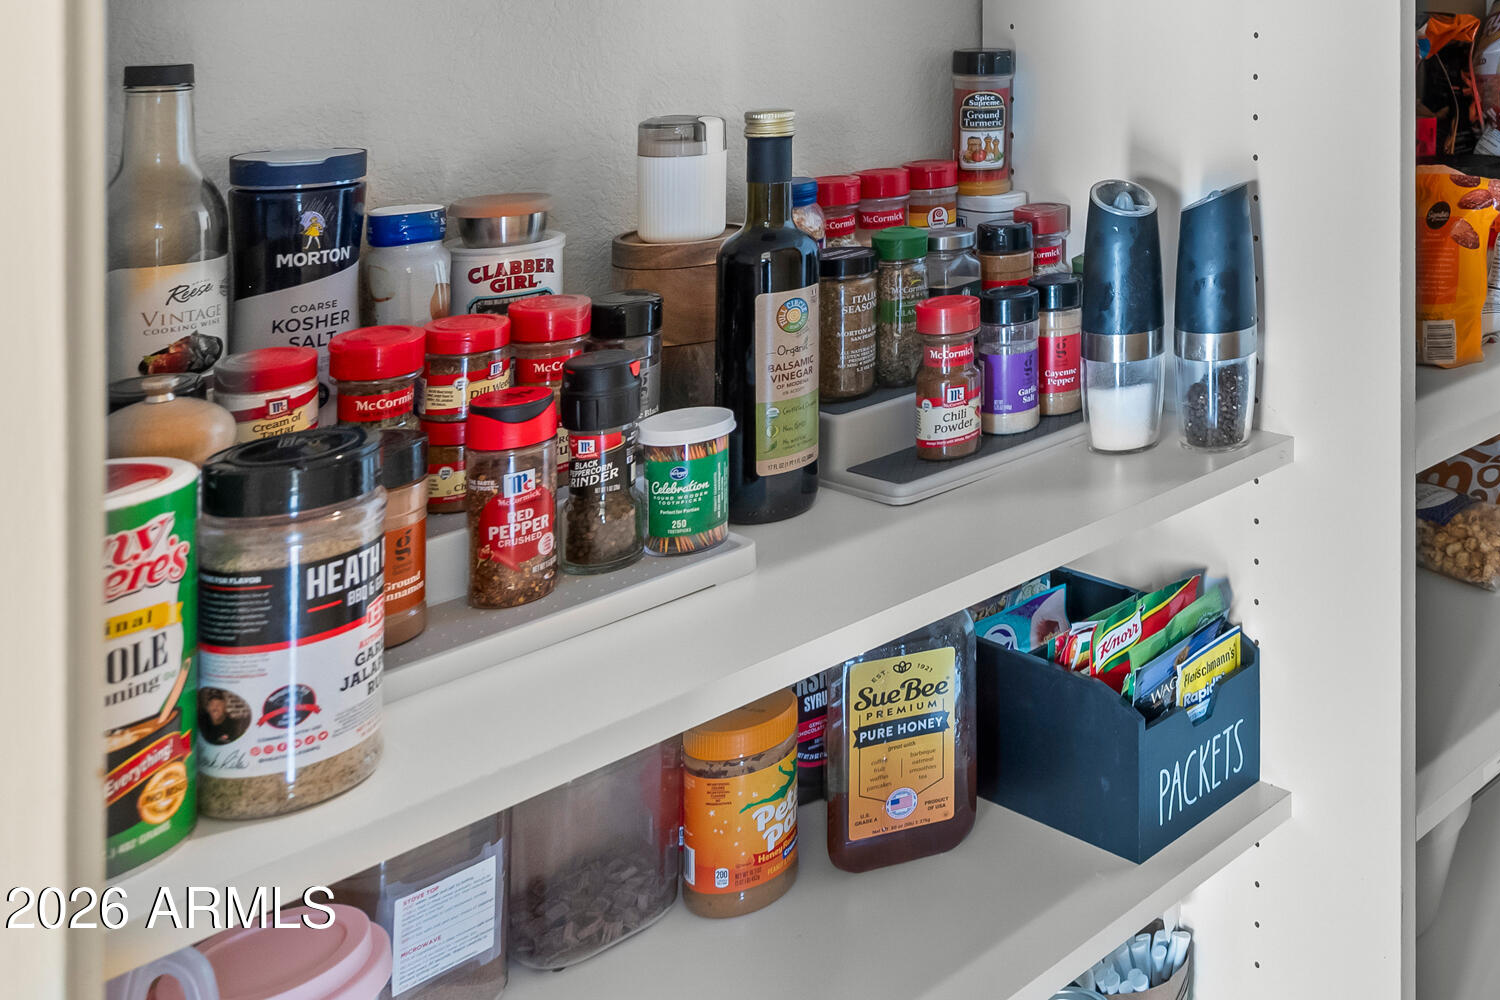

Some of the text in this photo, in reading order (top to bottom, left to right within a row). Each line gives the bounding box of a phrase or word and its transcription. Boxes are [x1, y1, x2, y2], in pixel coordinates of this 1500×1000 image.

[969, 99, 1000, 107] Supreme
[975, 94, 995, 102] Spice
[964, 118, 1002, 127] Turmeric
[966, 110, 1000, 120] Ground
[863, 211, 903, 224] McCormick
[276, 247, 350, 268] MORTON
[467, 258, 554, 284] CLABBER
[490, 275, 538, 293] GIRL
[166, 282, 213, 305] Reese
[291, 300, 338, 314] COARSE
[141, 304, 222, 327] VINTAGE
[272, 310, 350, 334] KOSHER
[143, 318, 221, 336] COOKING WINE
[288, 330, 337, 347] SALT
[930, 344, 973, 359] McCormick
[768, 354, 814, 373] BALSAMIC
[770, 365, 813, 385] VINEGAR
[1045, 367, 1077, 378] Cayenne
[776, 383, 786, 391] OF
[1047, 376, 1075, 386] Pepper
[470, 386, 490, 399] Dill
[1018, 386, 1036, 397] Garlic
[1023, 395, 1035, 403] Salt
[943, 408, 967, 422] Chili
[252, 421, 286, 434] Cream
[934, 417, 973, 434] Powder
[574, 459, 598, 471] BLACK
[651, 480, 710, 495] Celebration
[507, 508, 534, 524] RED
[488, 514, 549, 540] PEPPER
[671, 520, 687, 529] 250
[498, 533, 542, 548] CRUSHED
[306, 546, 380, 600] HEATH
[1098, 618, 1139, 660] Knorr
[872, 663, 934, 684] EST. 1921
[1184, 646, 1235, 686] Fleischmann's
[854, 677, 949, 712] Sue Bee
[866, 701, 938, 720] PREMIUM
[859, 716, 943, 743] PURE HONEY
[1159, 718, 1245, 826] PACKETS
[924, 797, 949, 806] PRODUCT
[716, 870, 728, 879] 200
[403, 886, 440, 907] STOVE TOP
[401, 935, 442, 958] MICROWAVE
